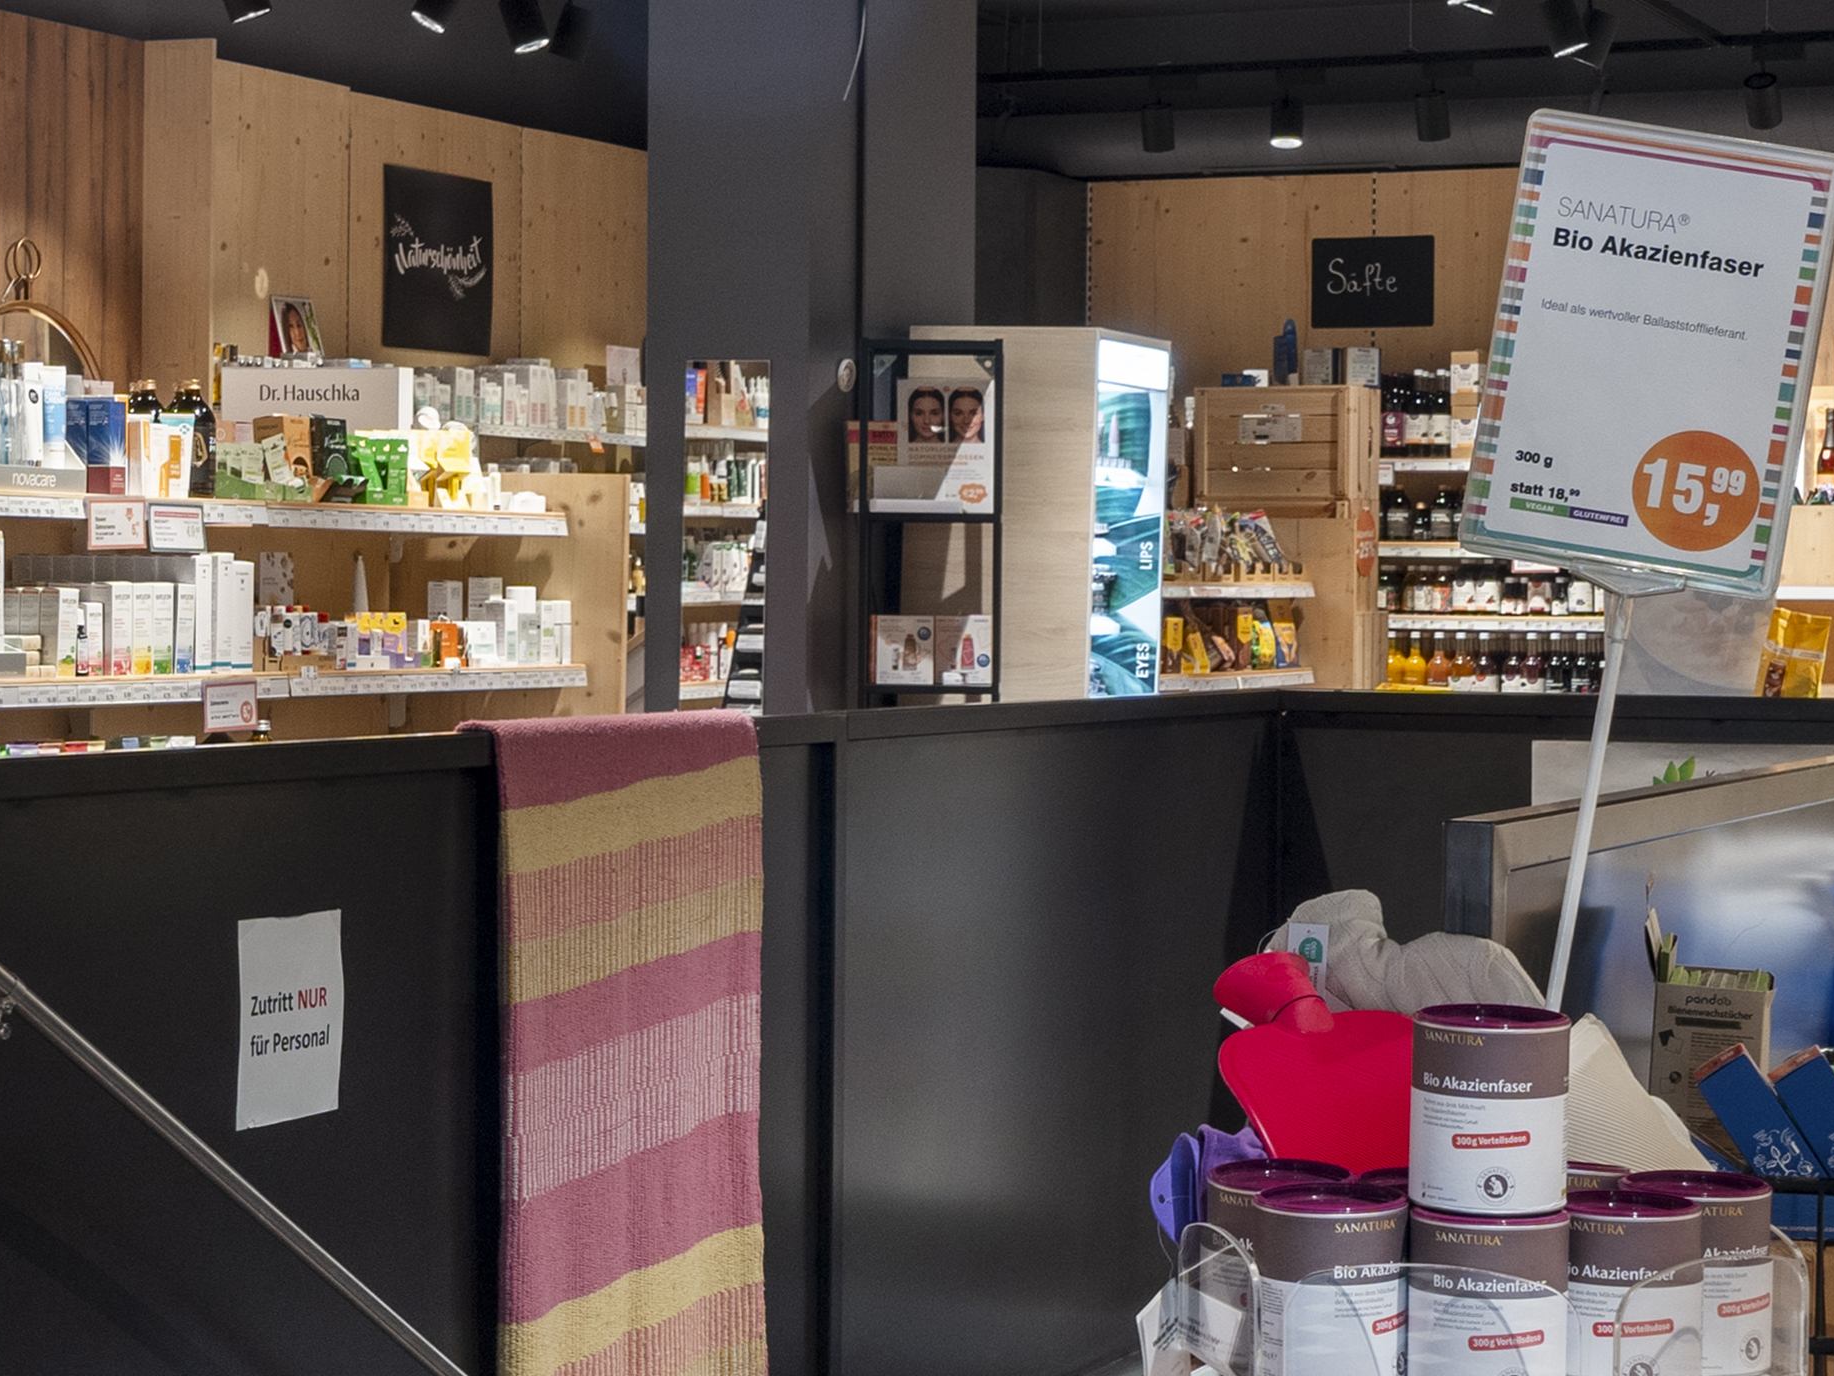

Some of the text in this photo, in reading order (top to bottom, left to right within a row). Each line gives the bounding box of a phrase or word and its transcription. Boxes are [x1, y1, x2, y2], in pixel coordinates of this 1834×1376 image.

[1552, 227, 1765, 277] Bio Akazienfaser
[1326, 257, 1398, 296] Säfte
[1541, 298, 1568, 313] Ideal
[1570, 302, 1586, 316] als
[1588, 306, 1641, 325] wertvoller
[259, 384, 360, 401] Dr. Hauschka
[1515, 450, 1554, 468] 300 g
[12, 472, 56, 488] novacare
[1510, 481, 1544, 498] statt
[1525, 500, 1625, 525] VEGAN GLUTENFREI
[1140, 541, 1153, 570] LIPS
[1135, 642, 1151, 679] EYES
[250, 986, 327, 1017] Zutritt NUR
[1667, 1005, 1753, 1021] Bienenwachstücher
[250, 1024, 330, 1057] für Personal
[1423, 1072, 1533, 1093] Bio Akazienfaser
[1568, 1221, 1626, 1235] ANATURA
[1334, 1265, 1357, 1280] Bio
[1581, 1265, 1675, 1281] Akazienfaser
[1433, 1274, 1547, 1293] Bio Akazienfaser
